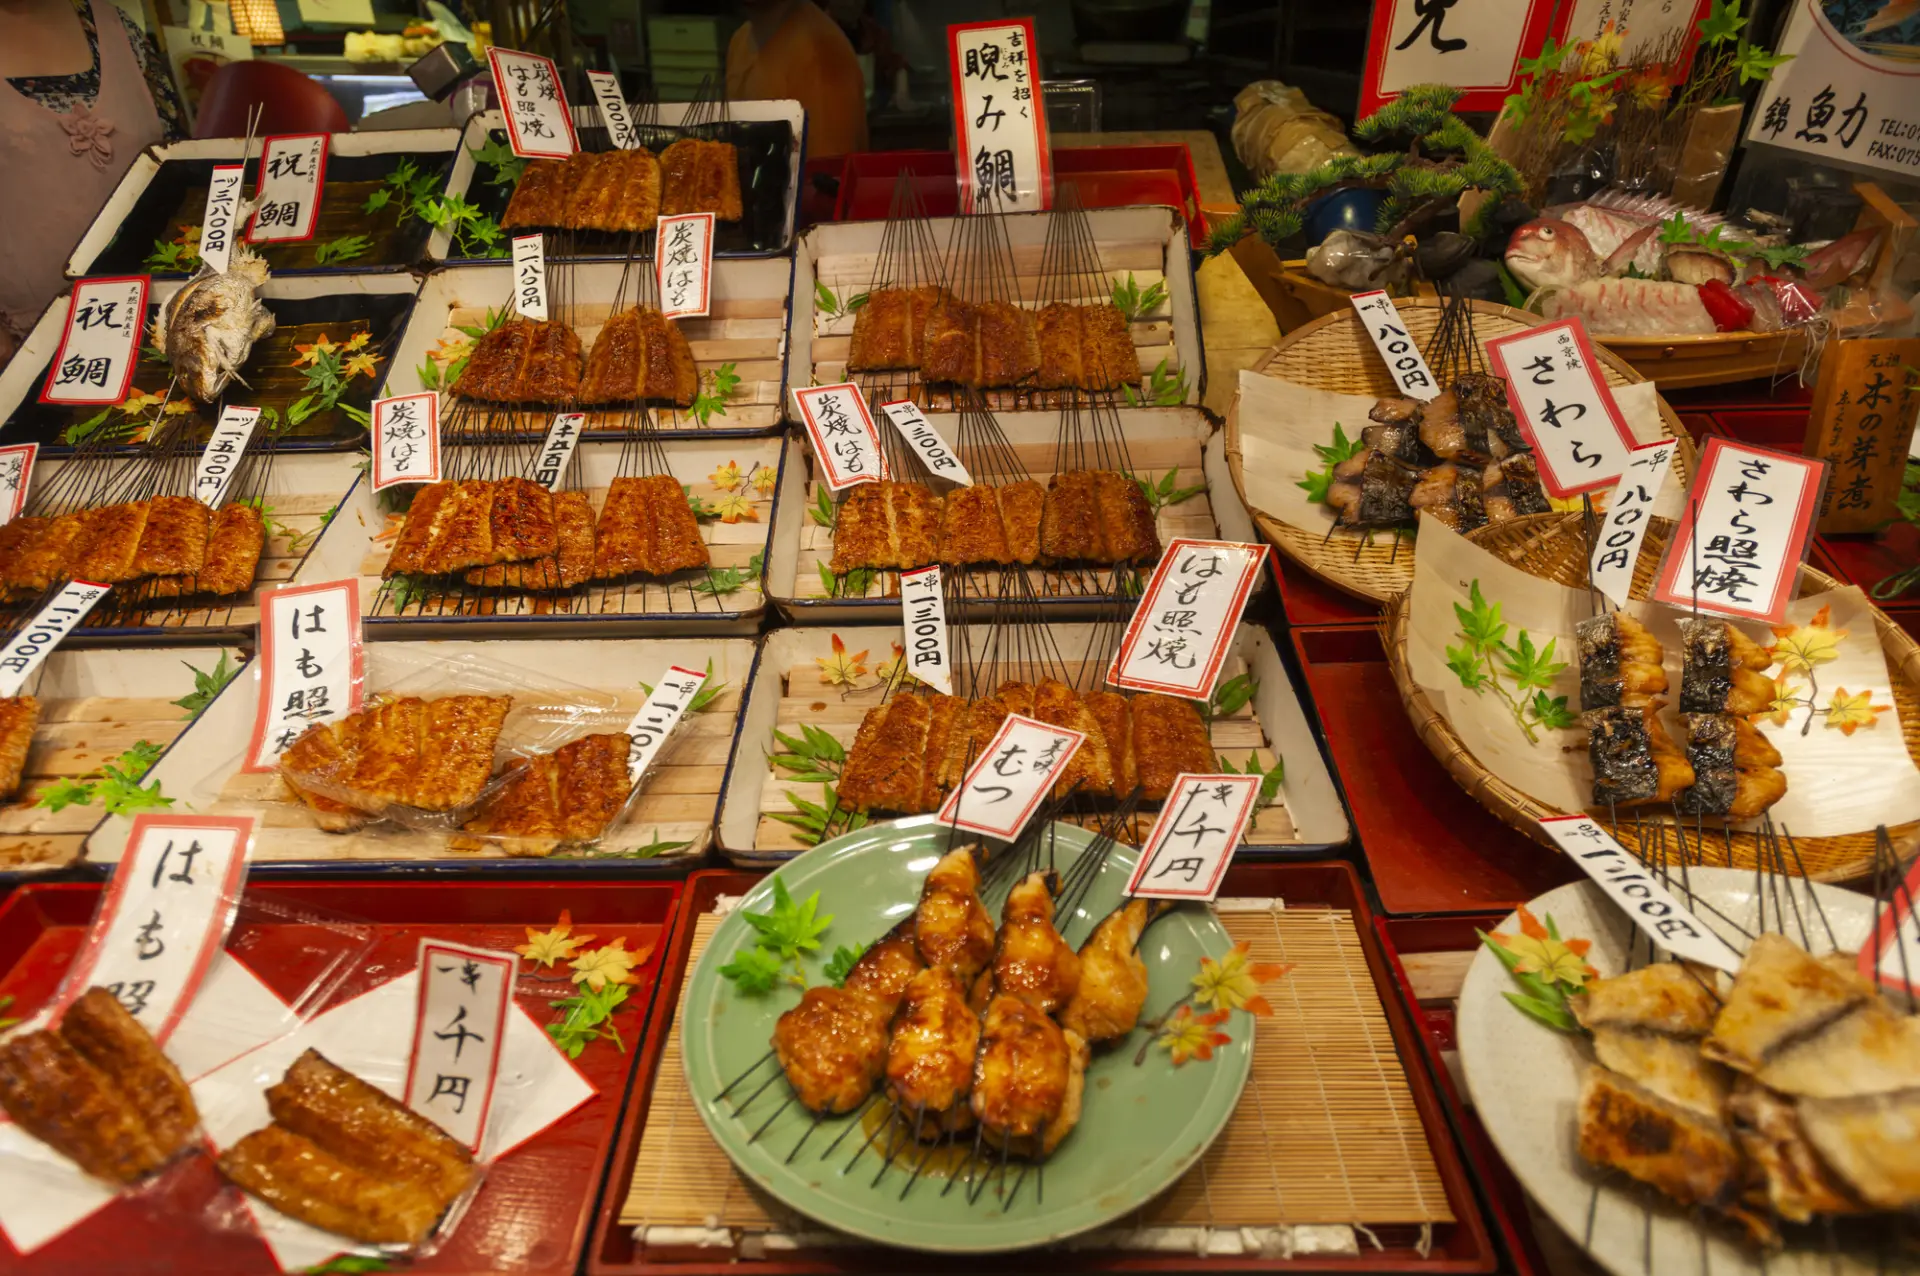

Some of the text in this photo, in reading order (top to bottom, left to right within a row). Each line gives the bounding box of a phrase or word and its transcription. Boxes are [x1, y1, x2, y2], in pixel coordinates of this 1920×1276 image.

[507, 64, 556, 139] はも照焼
[1006, 31, 1031, 119] 吉祥を招く
[964, 42, 1018, 202] 睨み鯛
[255, 150, 308, 230] 祝鯛
[665, 220, 700, 308] 炭焼はも
[55, 297, 123, 388] 祝鯛
[384, 400, 427, 473] 炭焼はも
[816, 393, 865, 474] 炭焼はも
[1520, 355, 1602, 469] さわら
[1837, 371, 1893, 511] 木の芽煮
[1690, 458, 1774, 603] さわら照焼
[1138, 553, 1226, 671] はも照焼
[972, 743, 1029, 805] むつ
